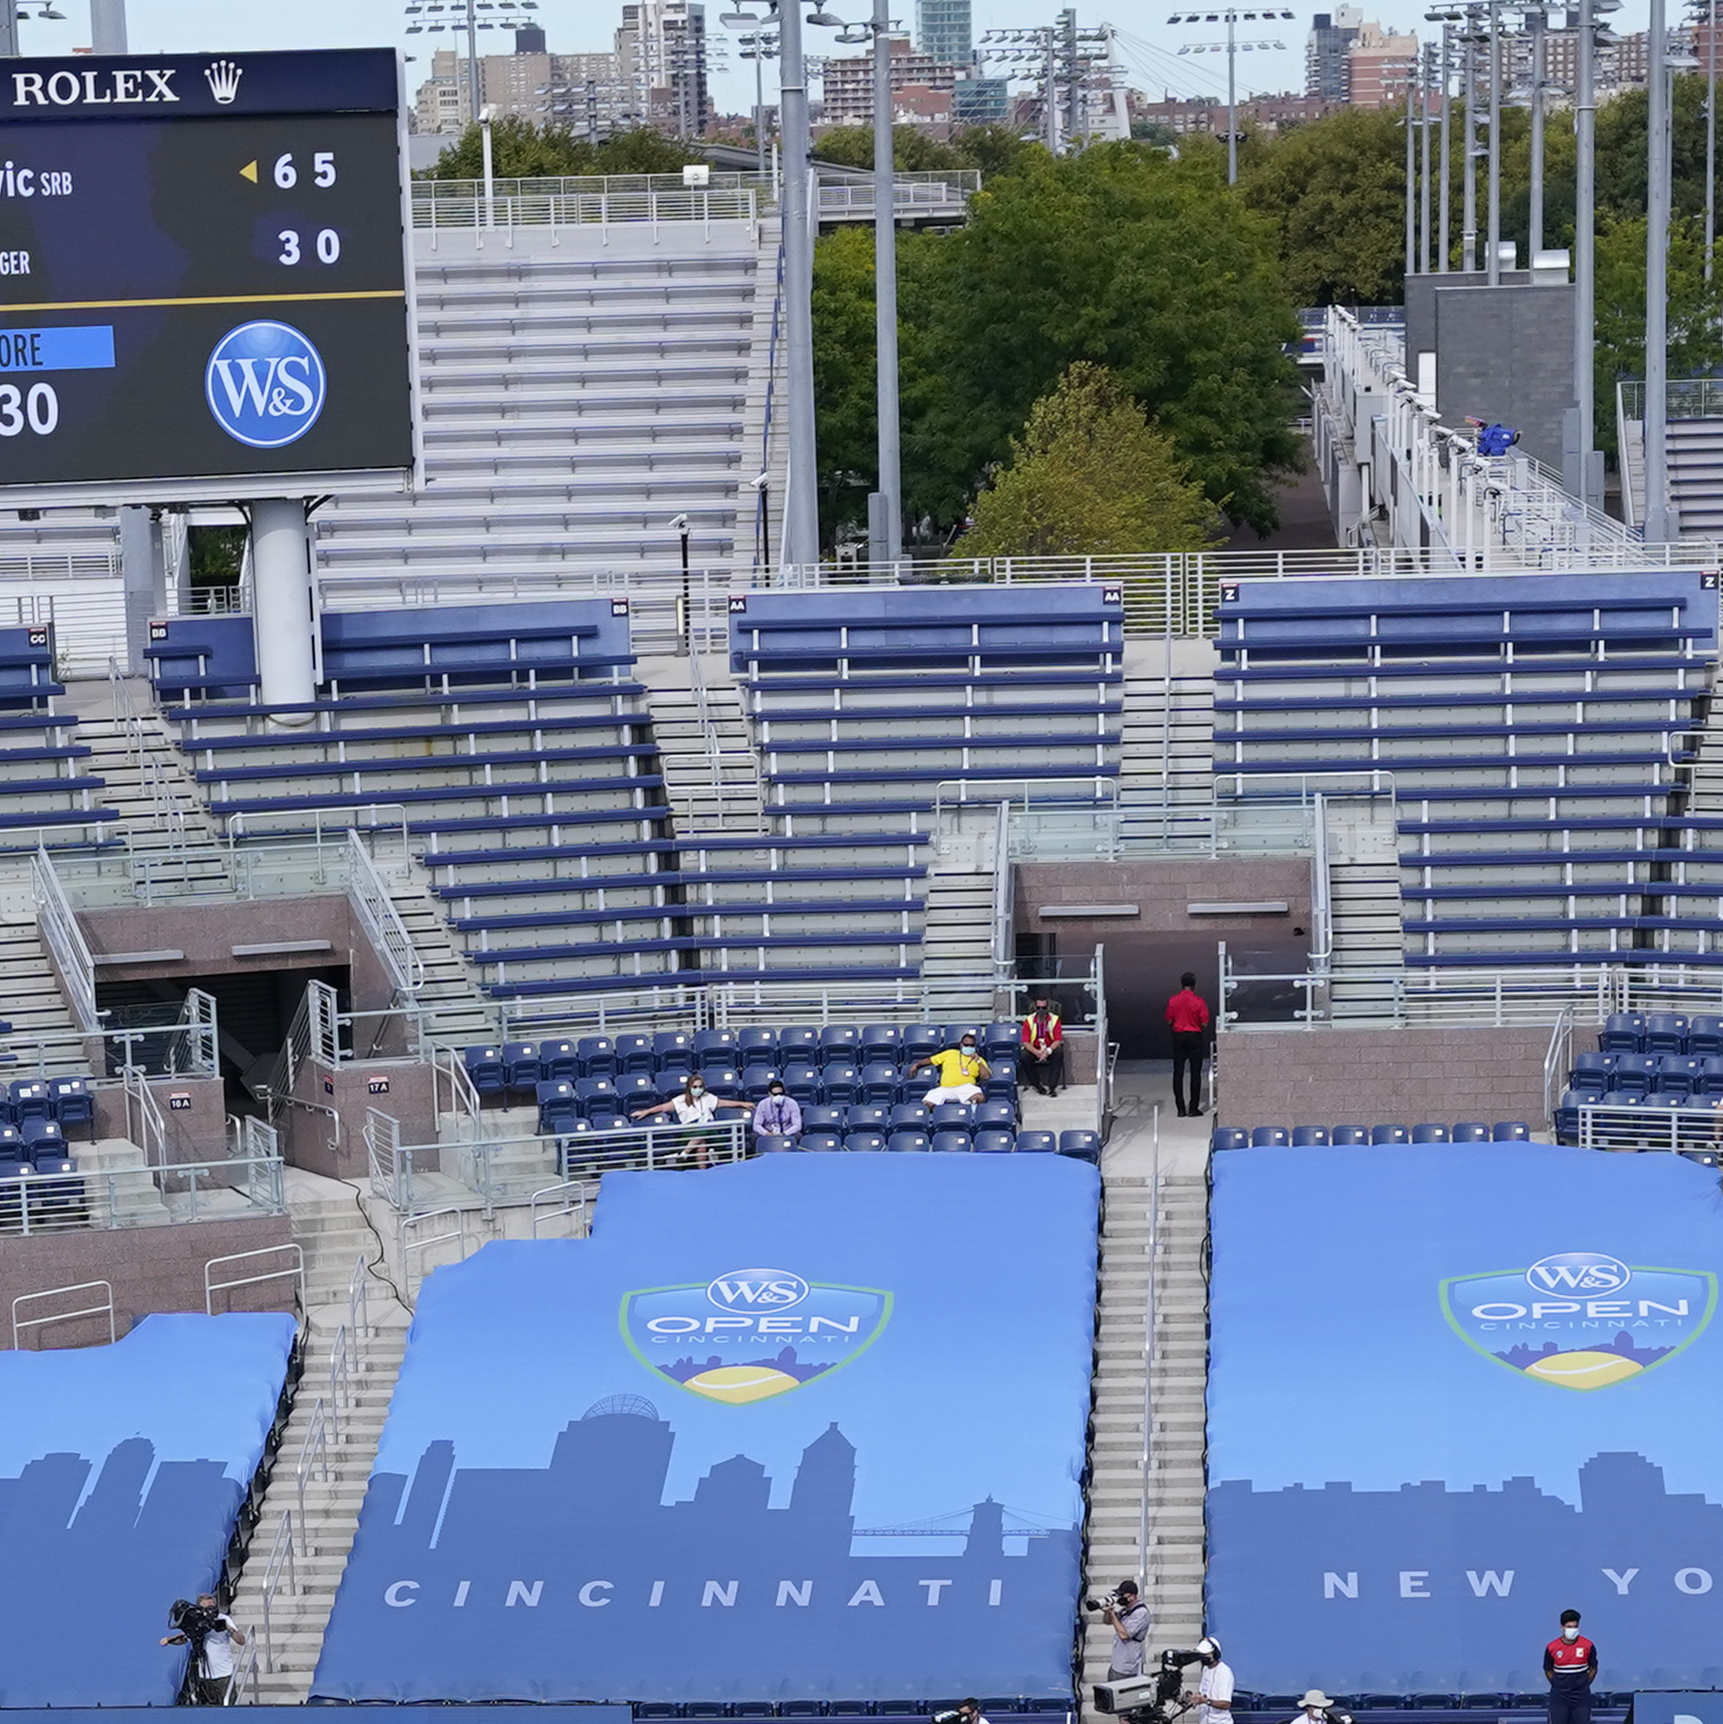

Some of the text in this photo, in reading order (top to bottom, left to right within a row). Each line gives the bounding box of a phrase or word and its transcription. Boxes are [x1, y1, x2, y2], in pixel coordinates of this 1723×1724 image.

[12, 69, 180, 107] ROLEX
[41, 172, 73, 196] SRB
[274, 153, 297, 189] 6
[314, 152, 336, 187] 5
[0, 251, 31, 275] GER
[278, 230, 300, 265] 3
[317, 229, 340, 263] 0
[214, 354, 314, 419] W&S
[1705, 576, 1715, 588] Z
[730, 601, 745, 611] AA
[1105, 592, 1120, 601] AA
[1225, 589, 1236, 601] Z
[30, 634, 46, 645] CC
[1535, 1262, 1621, 1290] W&S
[717, 1280, 799, 1304] W&S
[1471, 1299, 1690, 1321] OPEN
[646, 1315, 860, 1334] OPEN
[1480, 1319, 1684, 1331] CINCINNATI
[651, 1335, 851, 1344] CINCINNATI
[383, 1579, 1004, 1608] CINCINNATI
[1323, 1570, 1515, 1598] NEW
